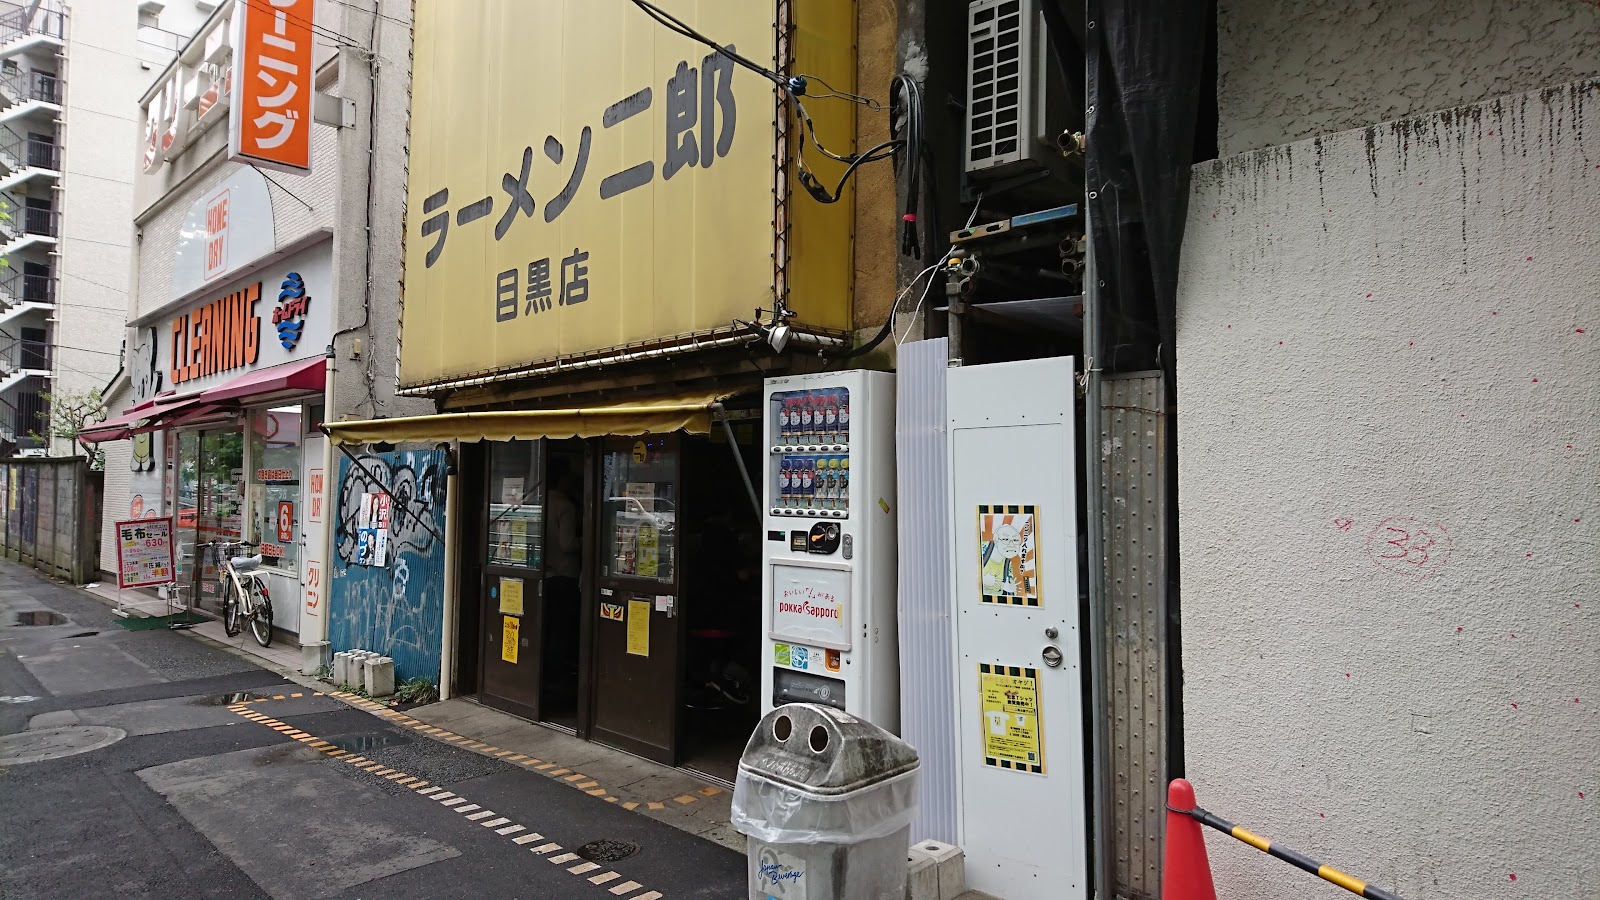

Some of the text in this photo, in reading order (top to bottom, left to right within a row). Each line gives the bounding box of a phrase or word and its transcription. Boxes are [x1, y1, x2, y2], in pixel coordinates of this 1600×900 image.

[421, 44, 737, 268] ラーメン二郎
[208, 199, 228, 237] HOME
[208, 235, 224, 271] DRY
[496, 248, 590, 323] 目黒店
[170, 282, 260, 384] CLEANING
[310, 474, 323, 495] HOM
[311, 497, 323, 518] DR
[121, 528, 168, 540] 毛布セール
[145, 538, 163, 547] 630
[308, 567, 320, 588] クリ
[307, 590, 319, 609] ニン
[758, 860, 783, 879] Japan
[769, 870, 806, 885] Beverage
